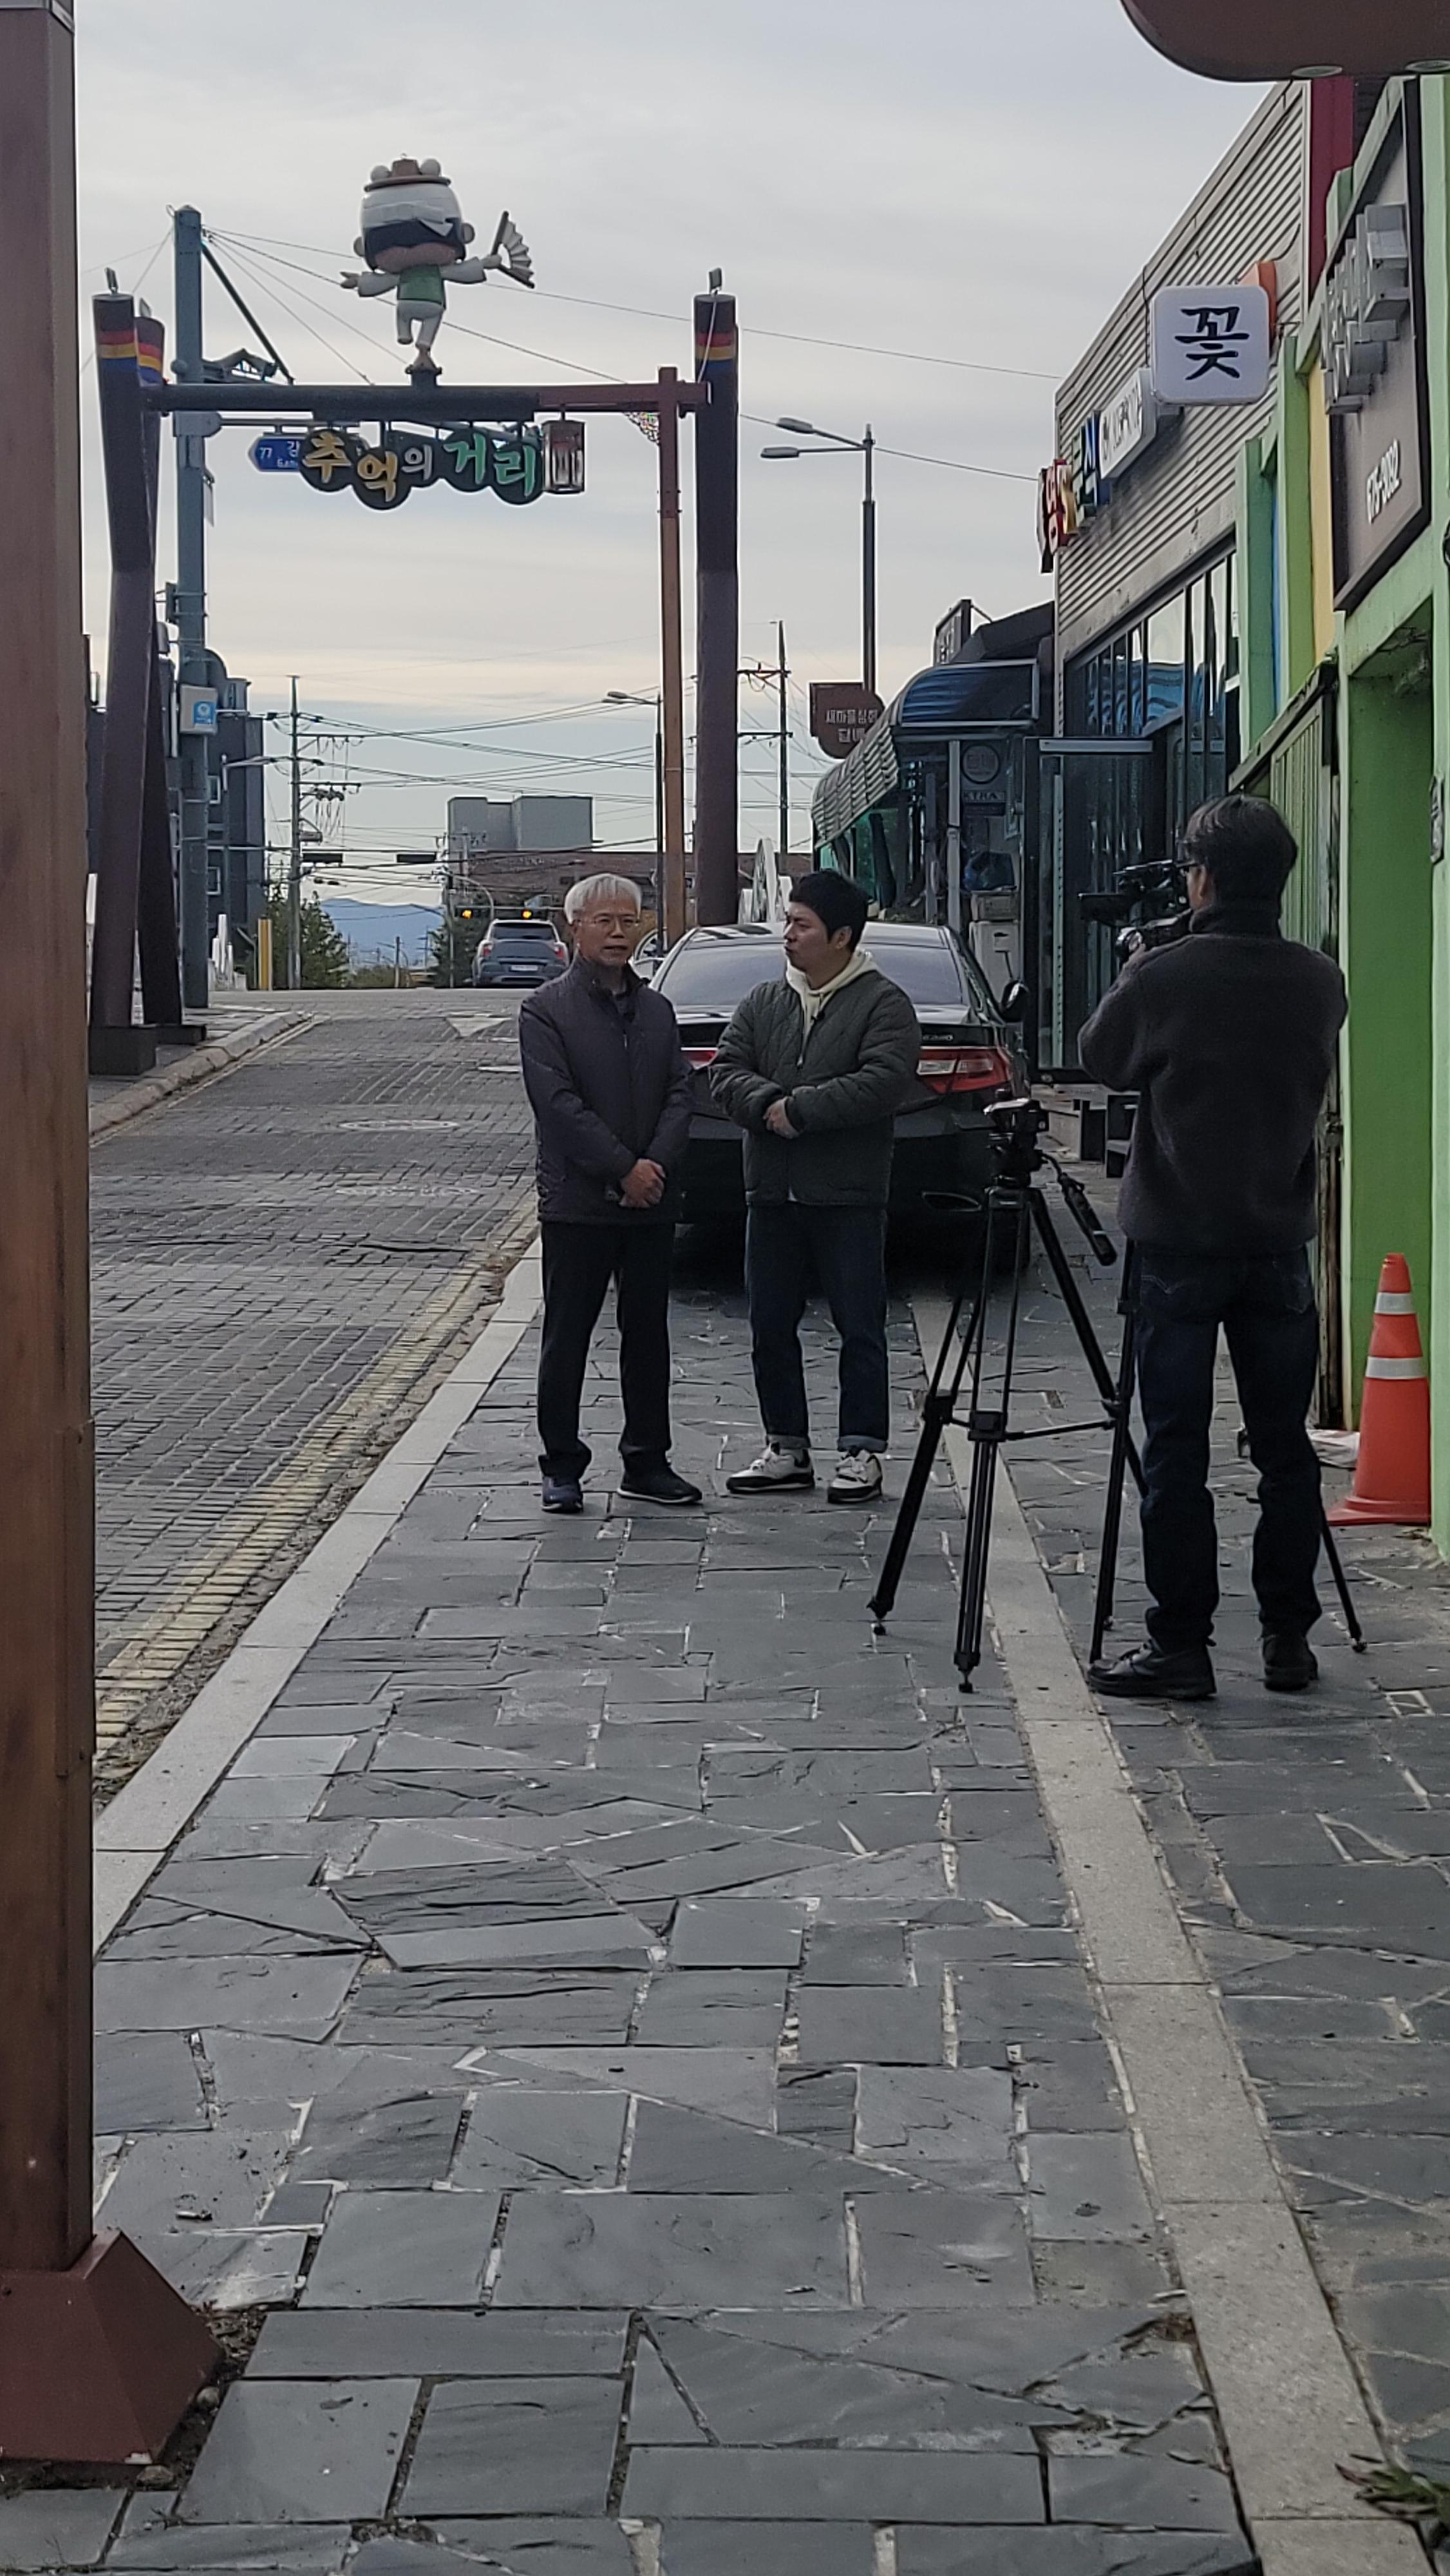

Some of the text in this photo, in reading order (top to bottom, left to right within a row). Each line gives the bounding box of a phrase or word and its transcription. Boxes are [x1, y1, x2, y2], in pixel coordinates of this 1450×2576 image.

[1174, 307, 1250, 381] 꽃
[302, 432, 536, 502] 추억의 거리
